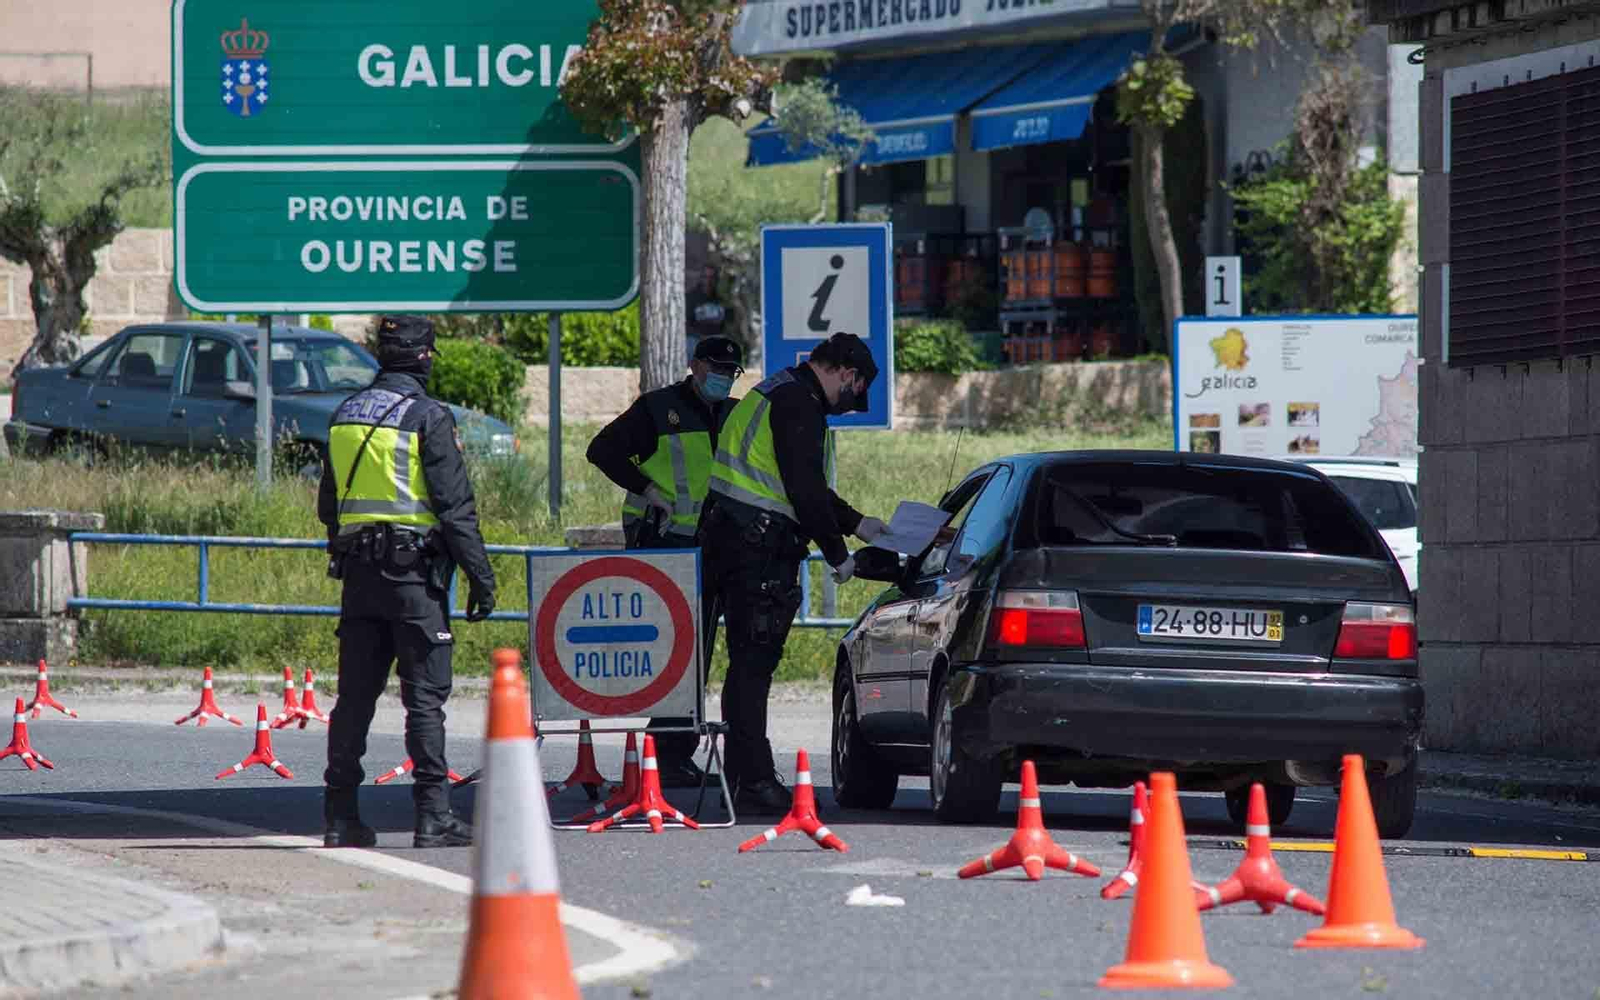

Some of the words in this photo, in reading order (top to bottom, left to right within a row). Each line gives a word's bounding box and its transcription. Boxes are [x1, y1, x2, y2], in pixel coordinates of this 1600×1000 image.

[787, 0, 961, 38] SUPERMERCADO
[287, 196, 467, 221] PROVINCIA
[487, 196, 529, 220] DE
[301, 240, 518, 273] OURENSE
[1184, 373, 1258, 398] galicia
[582, 591, 643, 620] ALTO
[575, 650, 652, 679] POLICIA
